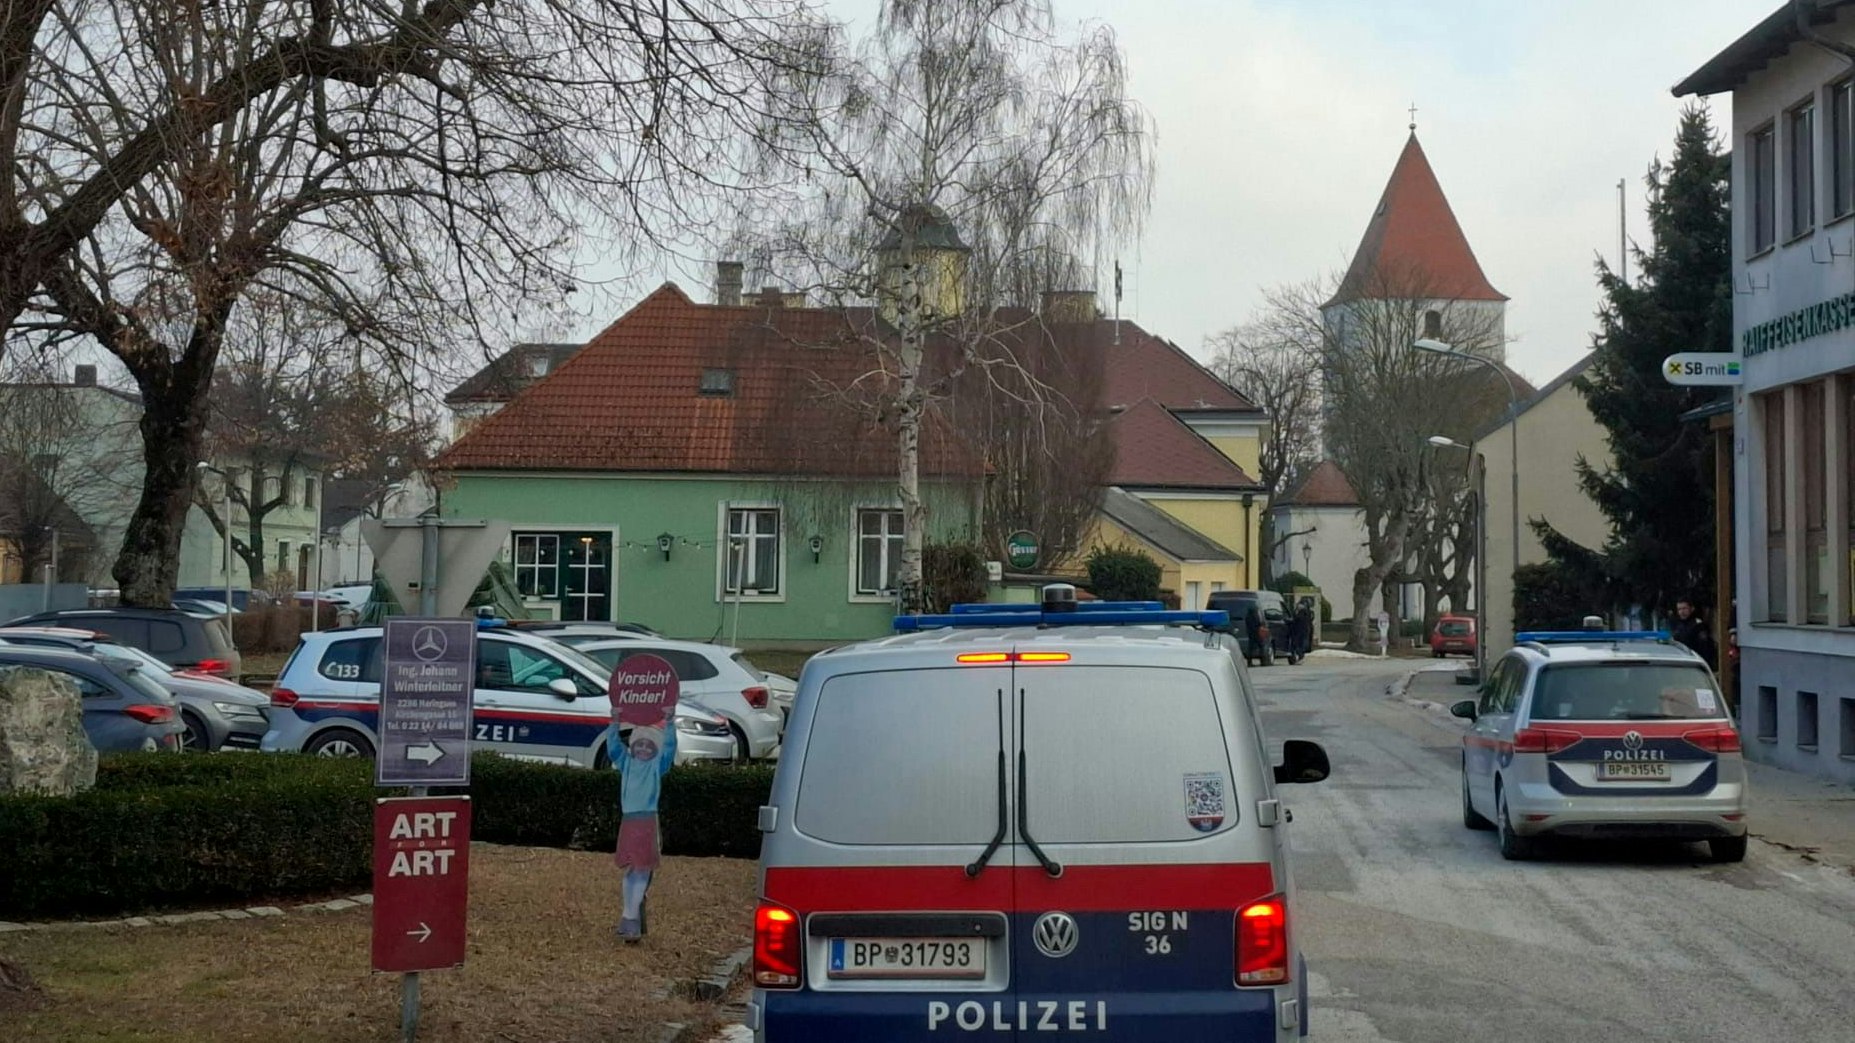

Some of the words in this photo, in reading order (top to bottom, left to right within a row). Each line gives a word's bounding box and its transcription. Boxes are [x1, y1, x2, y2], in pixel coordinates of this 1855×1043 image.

[1685, 362, 1703, 375] SB
[1705, 363, 1725, 375] mit
[337, 664, 360, 678] 133
[398, 665, 418, 678] Ing.
[420, 665, 457, 676] Johann
[617, 670, 671, 685] Vorsicht
[619, 689, 666, 704] Kinder!
[1604, 750, 1665, 760] POLIZEI
[1608, 764, 1623, 775] BP
[1631, 764, 1664, 775] 31545
[389, 812, 457, 839] ART
[388, 849, 455, 877] ART
[1128, 911, 1166, 931] SIG
[1172, 911, 1188, 931] N
[1145, 935, 1172, 954] 36
[854, 942, 881, 967] BP
[901, 942, 970, 967] 31793
[928, 1000, 1107, 1031] POLIZEI
